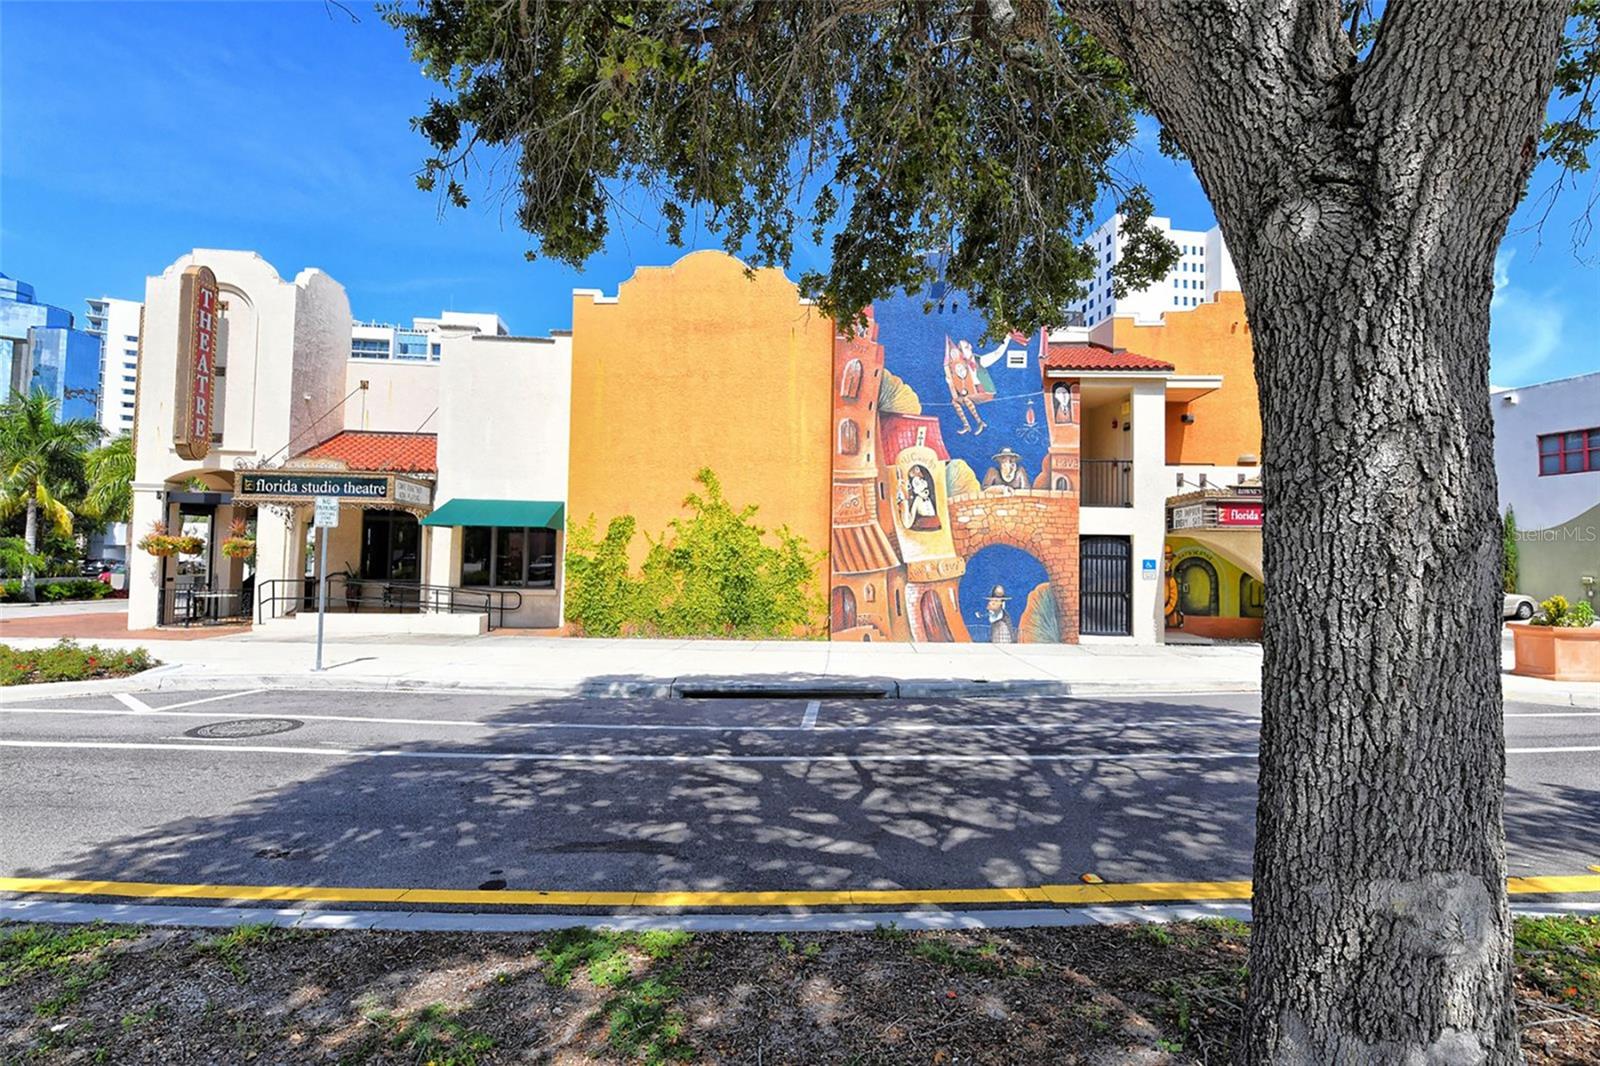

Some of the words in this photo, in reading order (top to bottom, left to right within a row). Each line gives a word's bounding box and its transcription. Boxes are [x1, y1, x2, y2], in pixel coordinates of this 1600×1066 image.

[195, 287, 213, 437] THEATRE
[256, 479, 298, 493] florida
[301, 480, 340, 494] studio
[343, 481, 386, 495] theatre
[1231, 509, 1259, 520] florida
